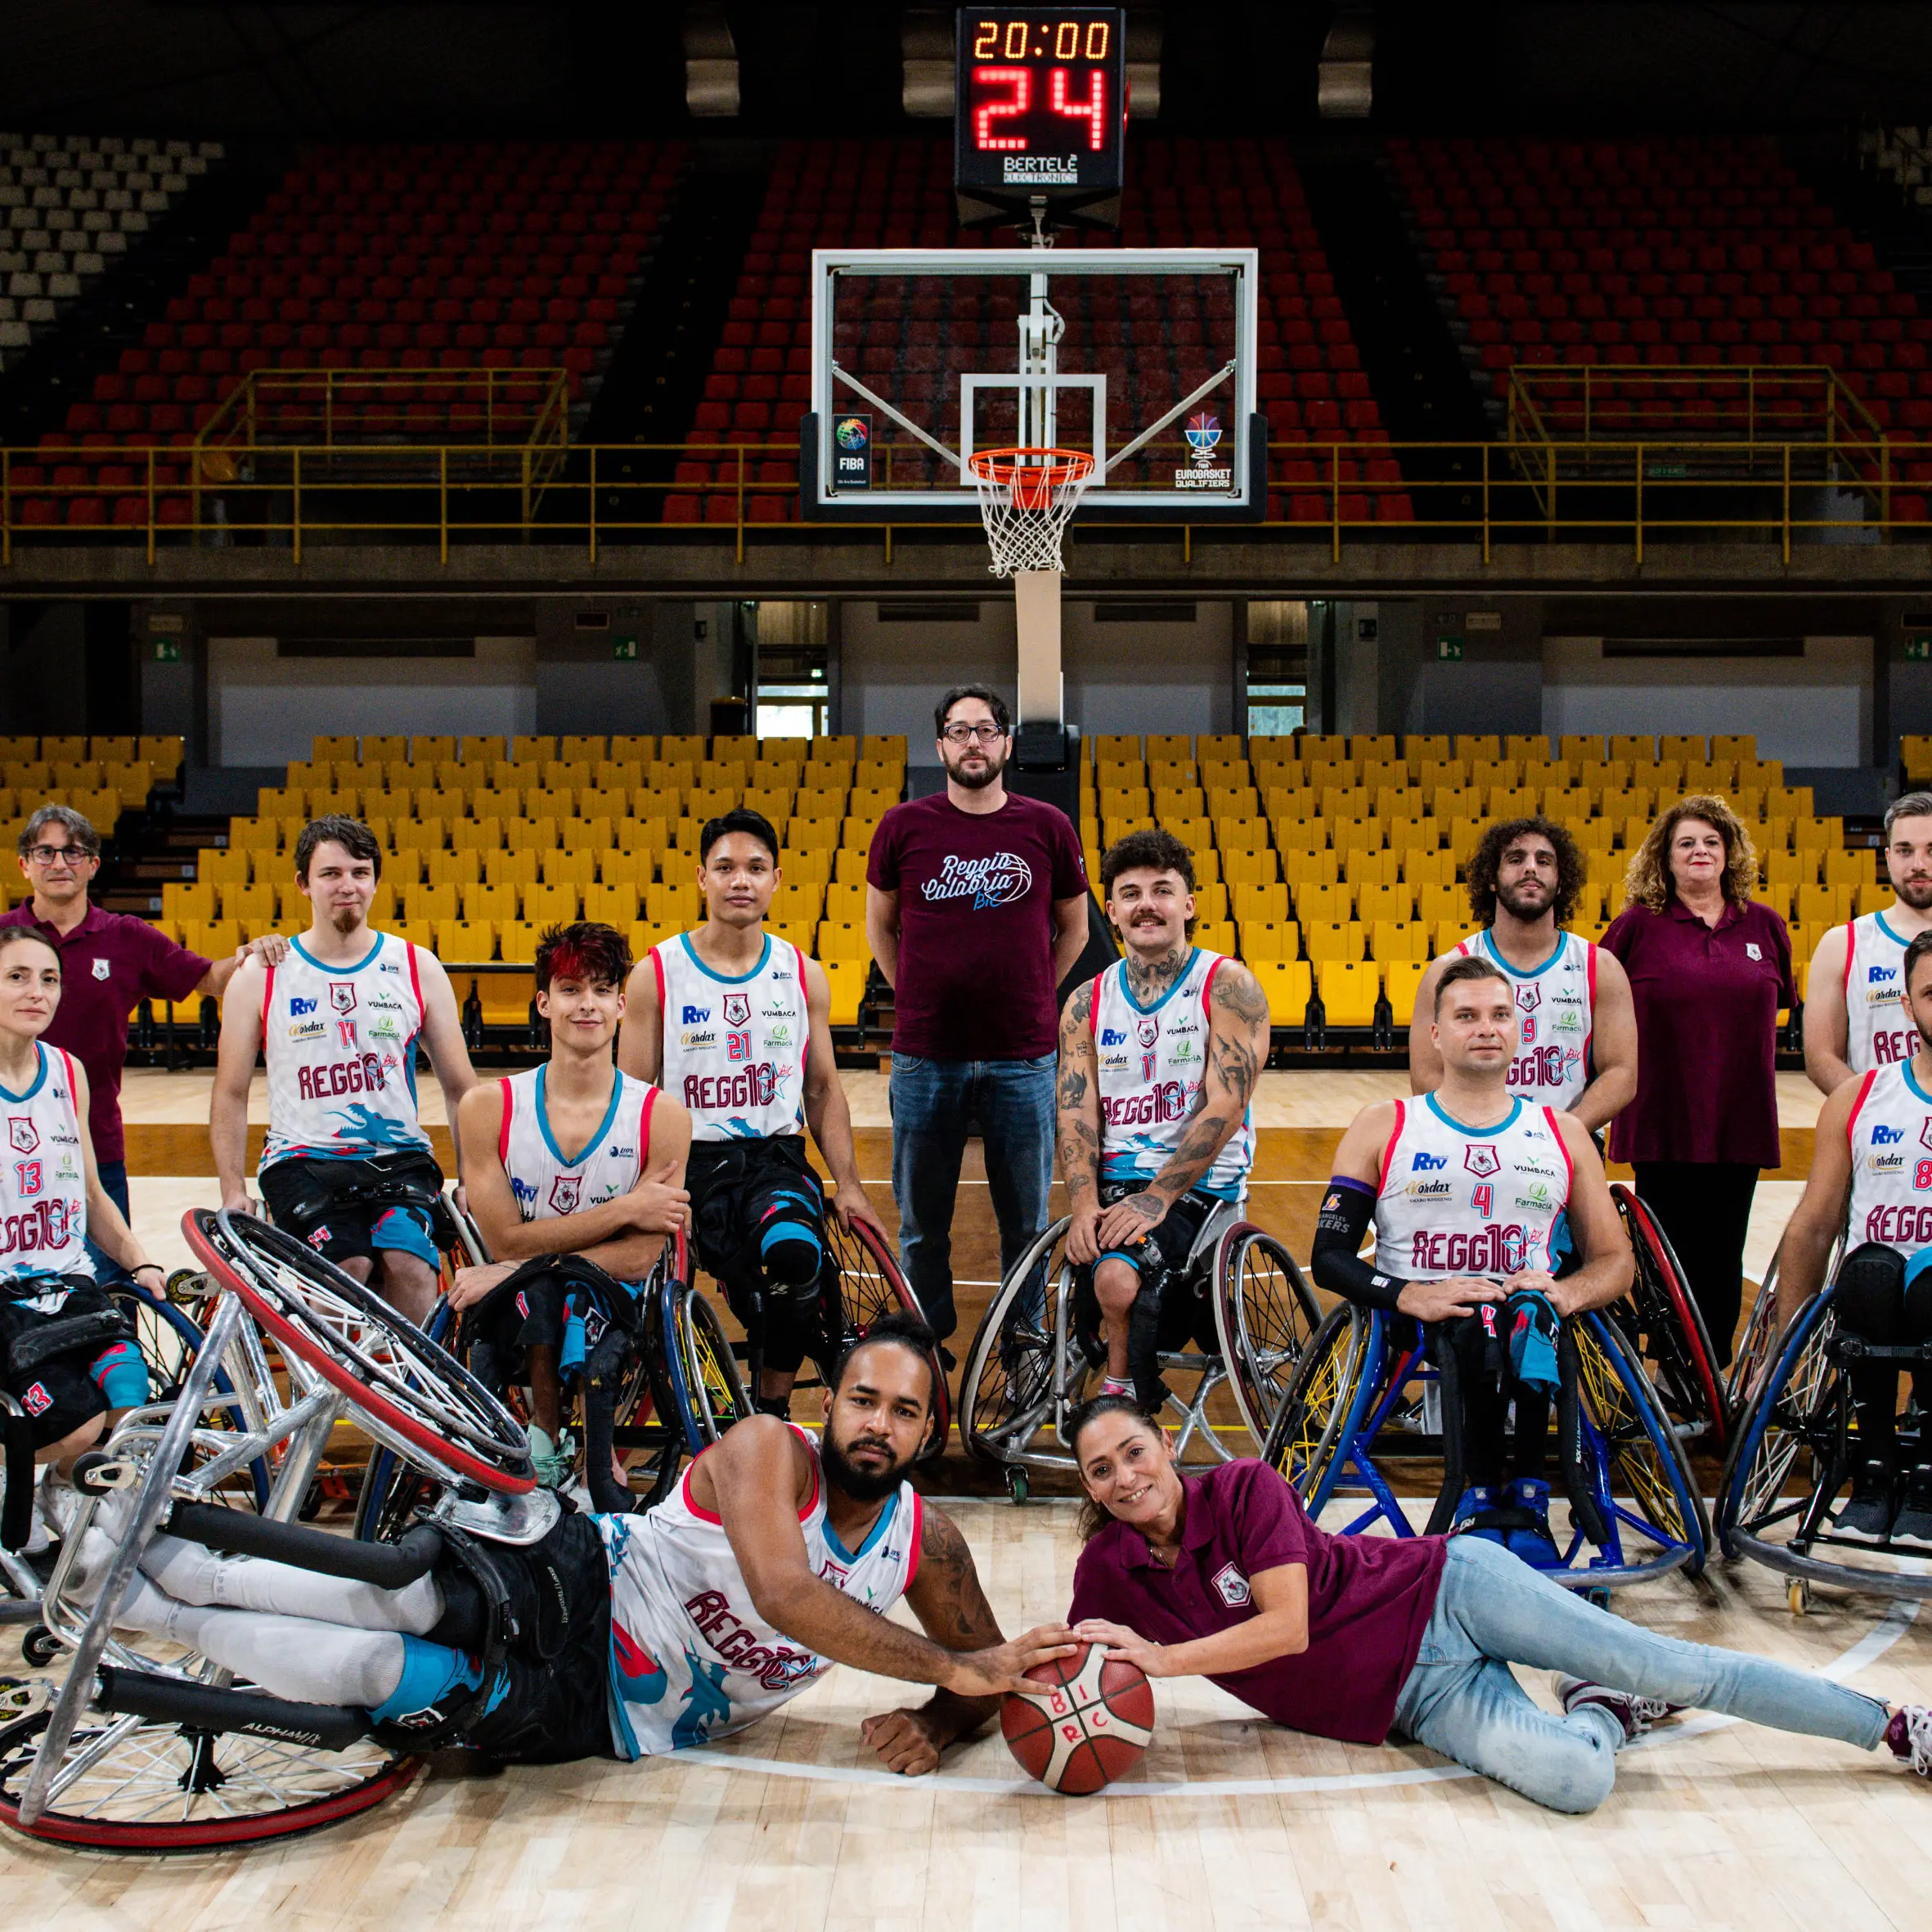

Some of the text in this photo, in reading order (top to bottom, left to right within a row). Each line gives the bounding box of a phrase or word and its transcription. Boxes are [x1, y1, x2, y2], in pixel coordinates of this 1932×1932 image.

[974, 22, 1108, 60] 20:00
[973, 66, 1103, 151] 24
[839, 457, 865, 470] FIBA
[1175, 469, 1232, 480] EUROBASKET
[1175, 479, 1230, 488] QUALIFIERS
[940, 851, 1012, 884] Reggio
[921, 872, 1013, 901] Calabria
[367, 1000, 403, 1011] VUMBACA
[1166, 1025, 1199, 1035] VUMBACA
[1521, 1016, 1537, 1045] 9
[726, 1031, 752, 1062] 21
[1873, 1031, 1921, 1065] REG
[1139, 1051, 1157, 1084] 11
[14, 1158, 43, 1197] 13
[1514, 1165, 1556, 1178] VUMBACA
[1471, 1183, 1494, 1219] 4
[1319, 1219, 1350, 1233] KERS
[1866, 1205, 1932, 1243] REGG
[1480, 1303, 1498, 1338] 4
[21, 1380, 55, 1418] 13
[1050, 1691, 1067, 1714] B
[1061, 1711, 1108, 1744] R C
